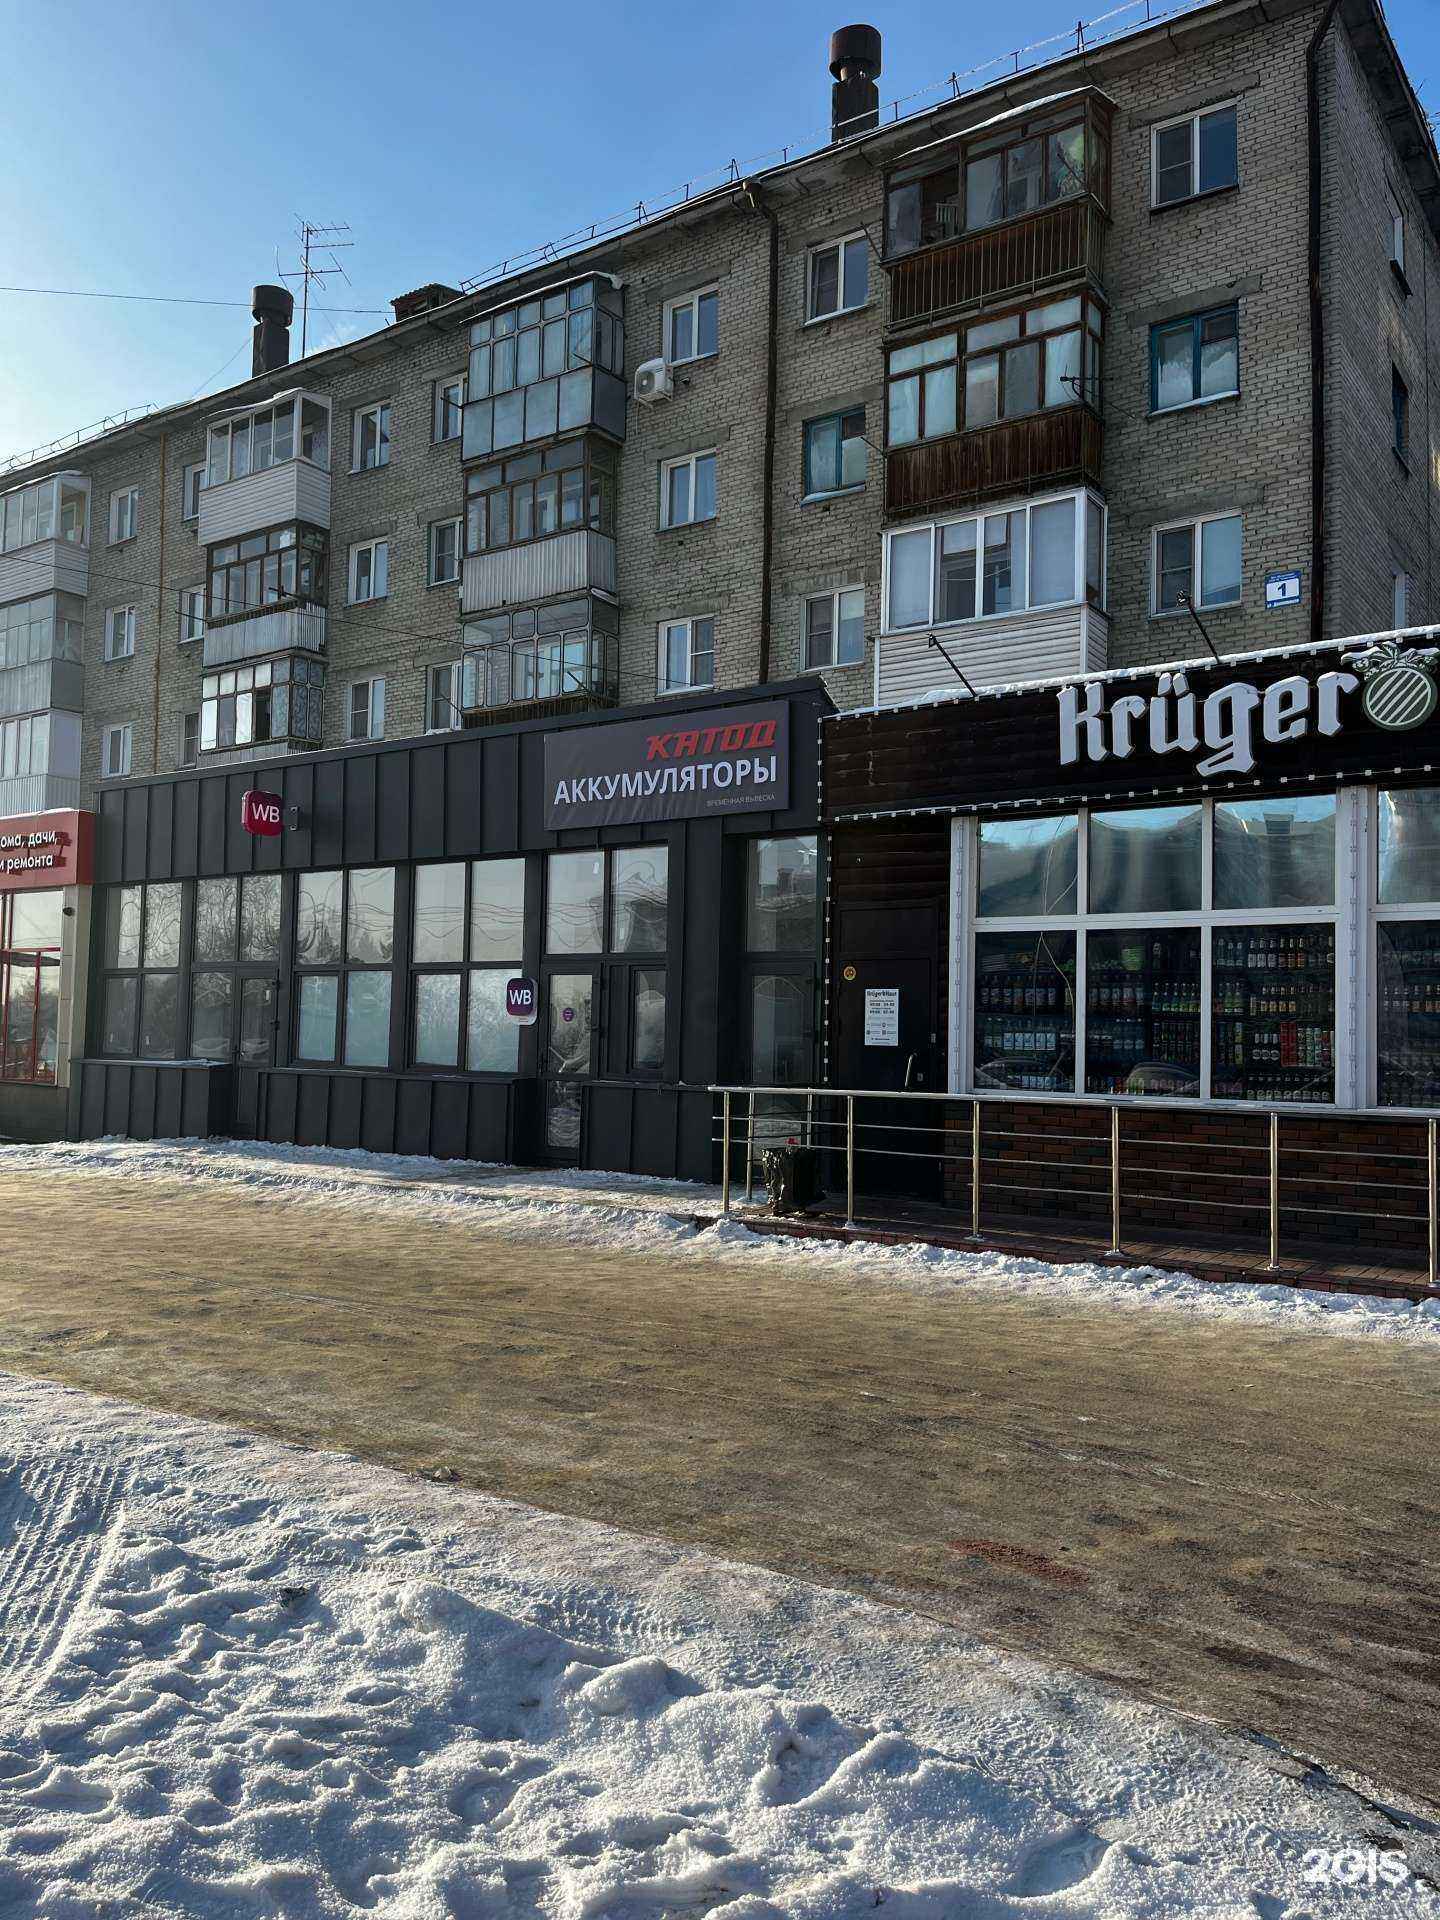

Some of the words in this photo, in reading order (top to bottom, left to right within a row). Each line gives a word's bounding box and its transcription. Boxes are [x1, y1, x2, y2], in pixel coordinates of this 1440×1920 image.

[1278, 582, 1287, 597] 1
[1056, 671, 1361, 777] Krüger
[553, 755, 777, 805] АККУМУЛЯТОРЫ
[252, 802, 280, 823] WB
[0, 833, 25, 848] ома,
[27, 830, 58, 848] дачи,
[6, 855, 53, 874] ремонта
[509, 989, 532, 1005] WB
